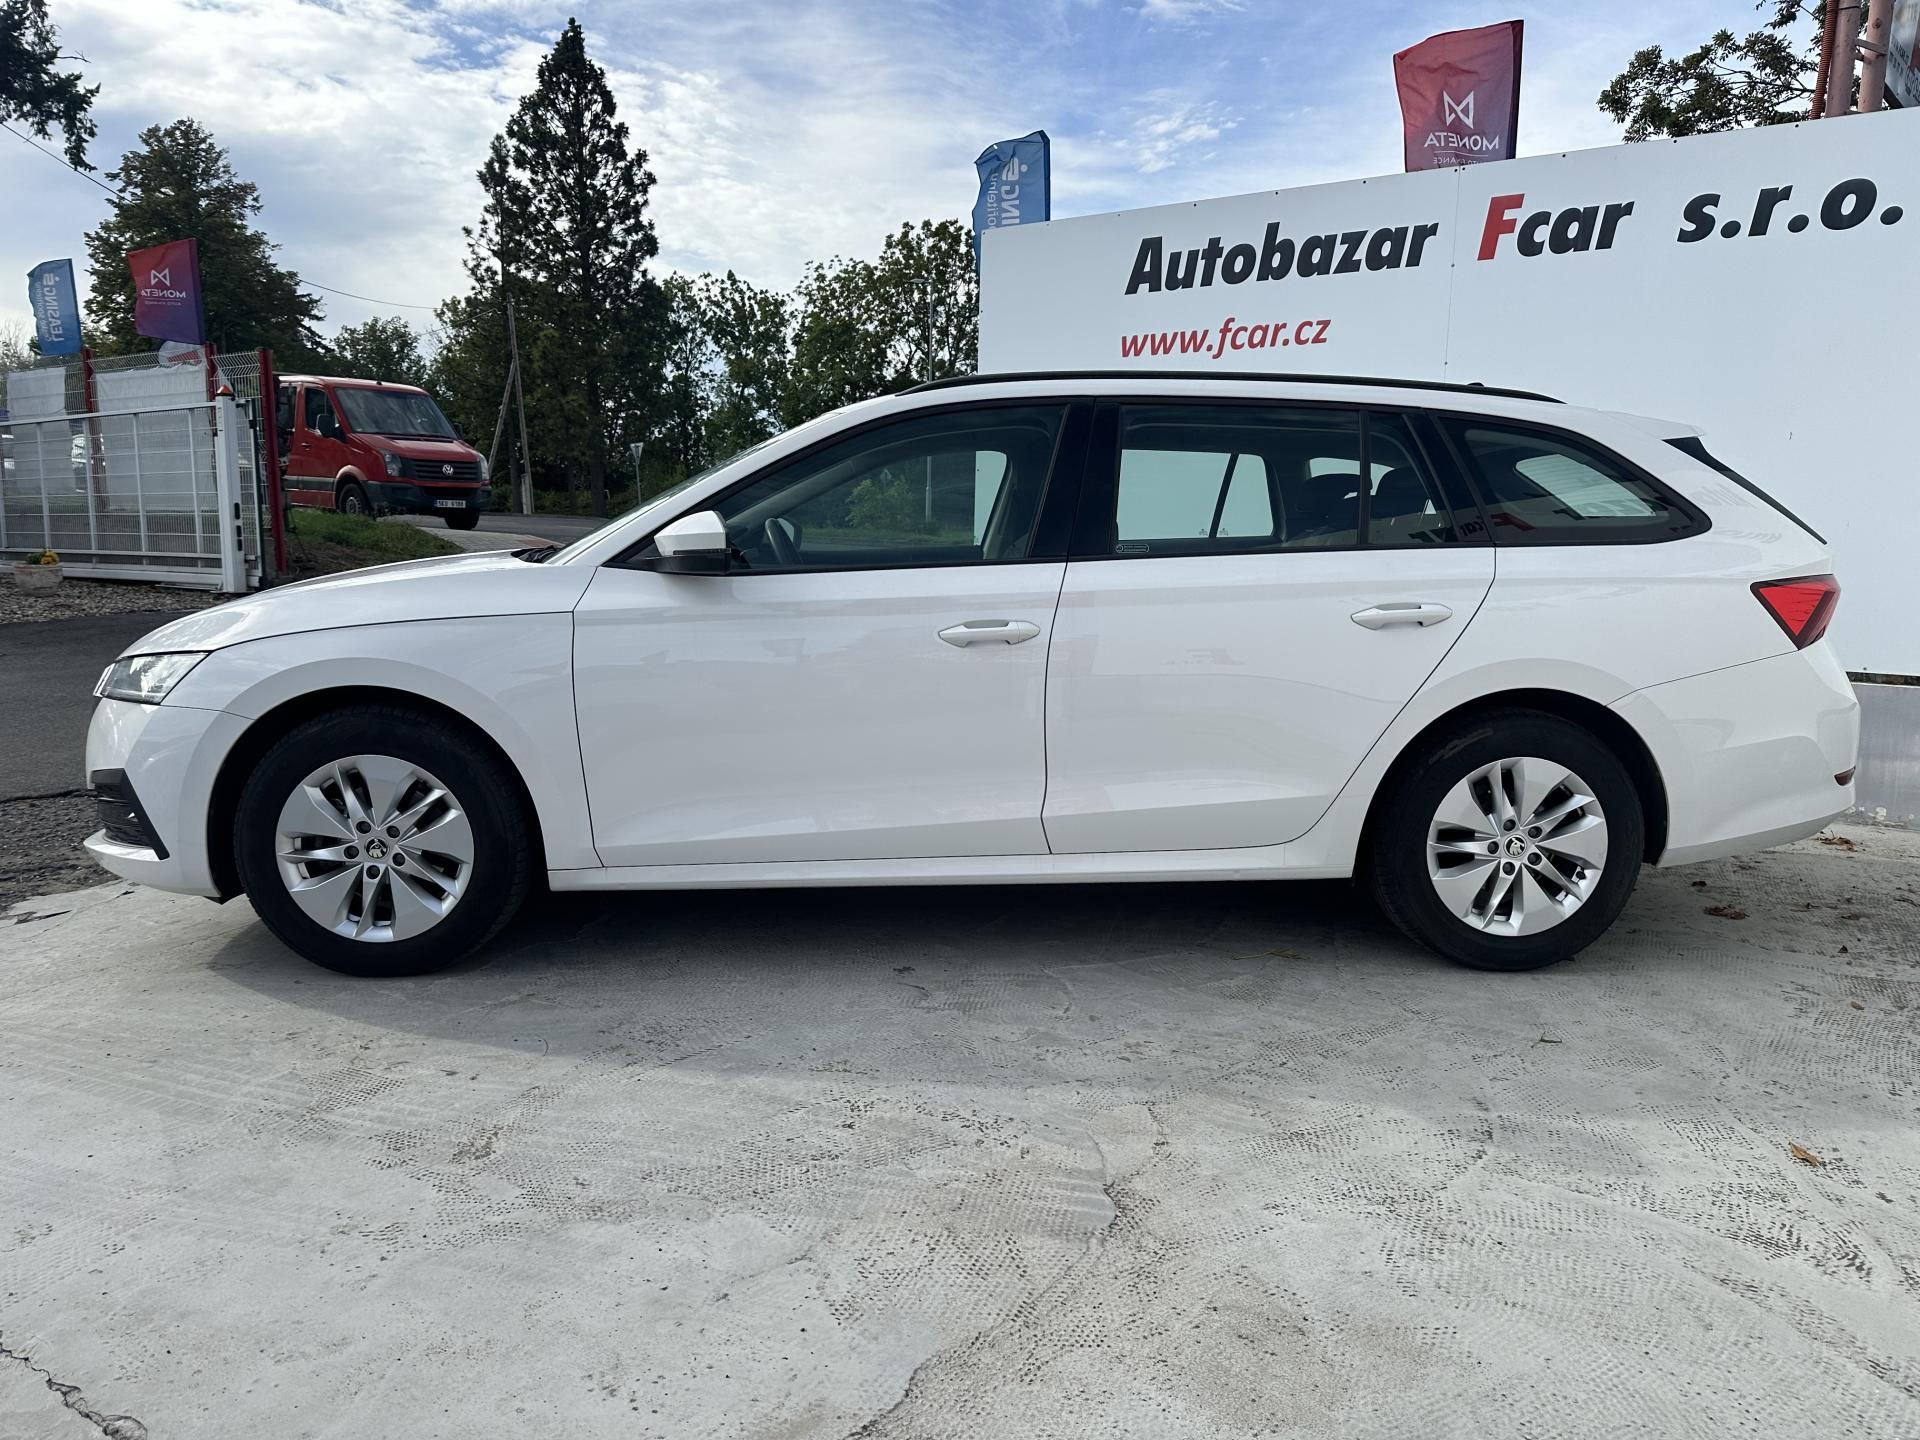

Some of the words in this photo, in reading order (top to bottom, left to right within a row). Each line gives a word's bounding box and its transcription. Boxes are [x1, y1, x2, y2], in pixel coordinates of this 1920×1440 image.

[1124, 221, 1439, 295] Autobazar
[1477, 193, 1635, 261] Fcar
[1676, 178, 1904, 243] s.r.o.
[1121, 317, 1331, 359] www.fcar.cz
